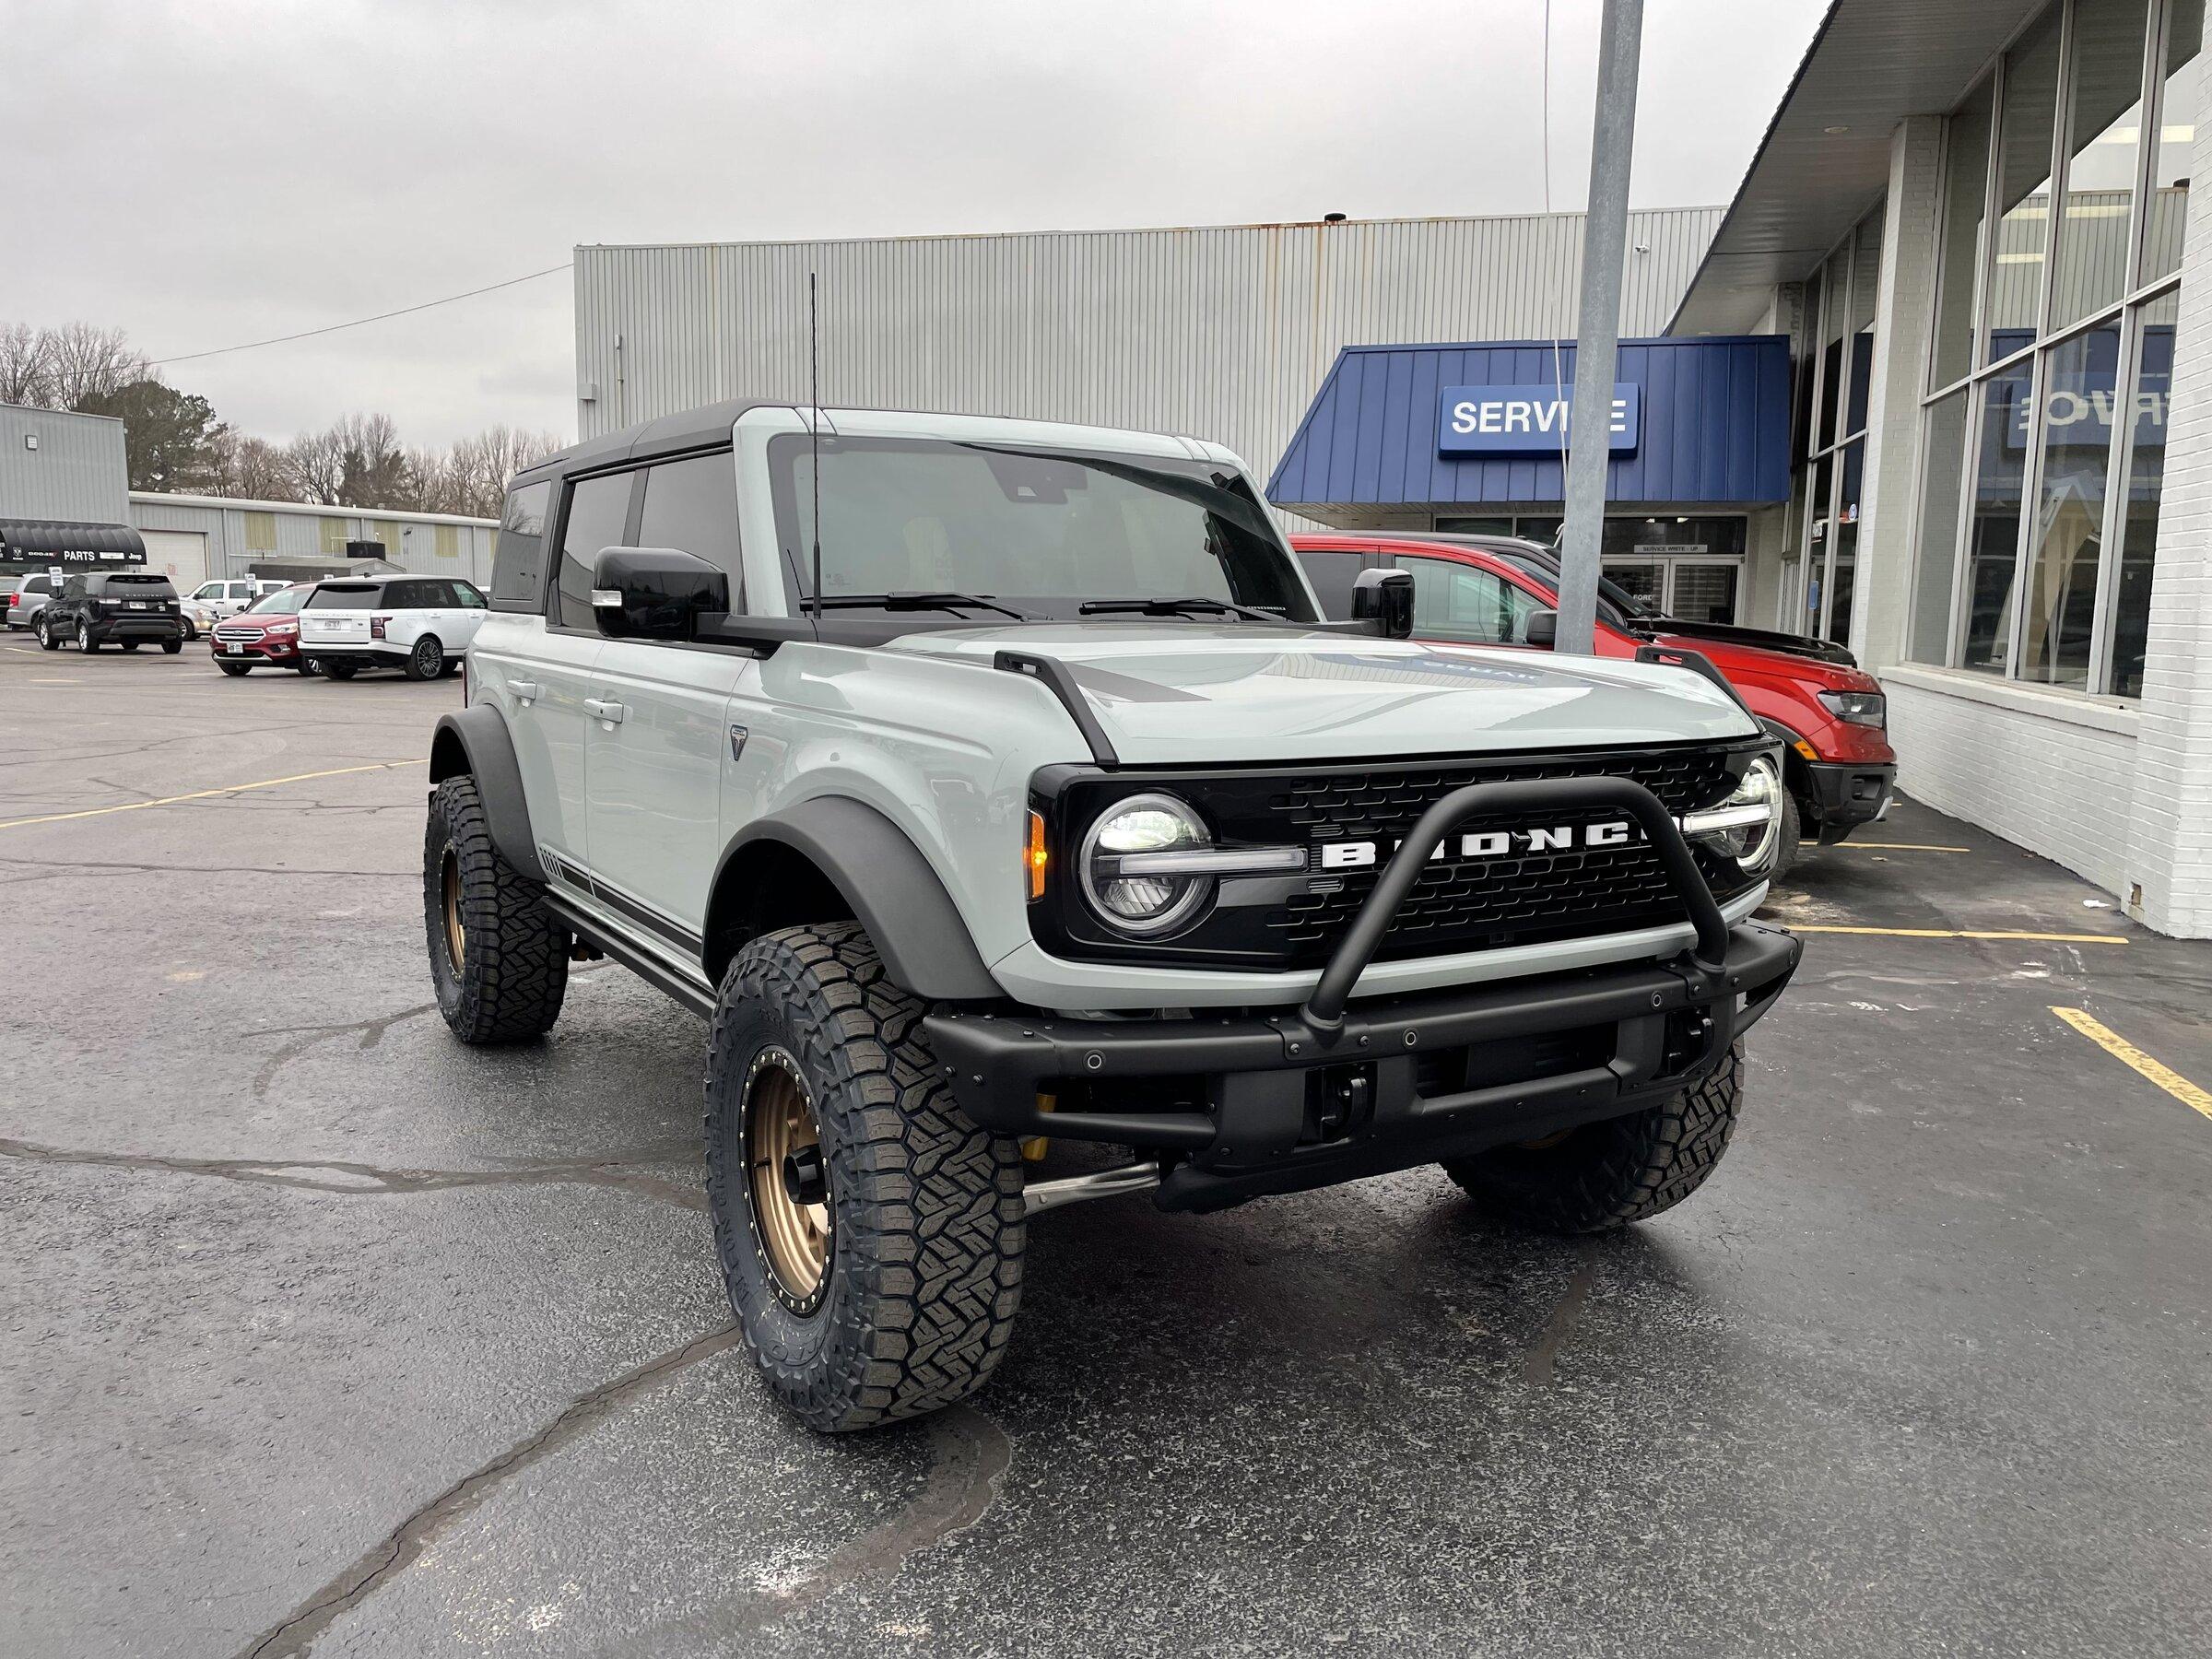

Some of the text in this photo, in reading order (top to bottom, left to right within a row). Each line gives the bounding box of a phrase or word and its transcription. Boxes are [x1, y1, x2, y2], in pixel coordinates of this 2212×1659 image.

[1452, 400, 1627, 433] SERVIE
[64, 550, 95, 561] PARTS
[128, 552, 142, 560] Jeep
[1322, 816, 1680, 868] BONC
